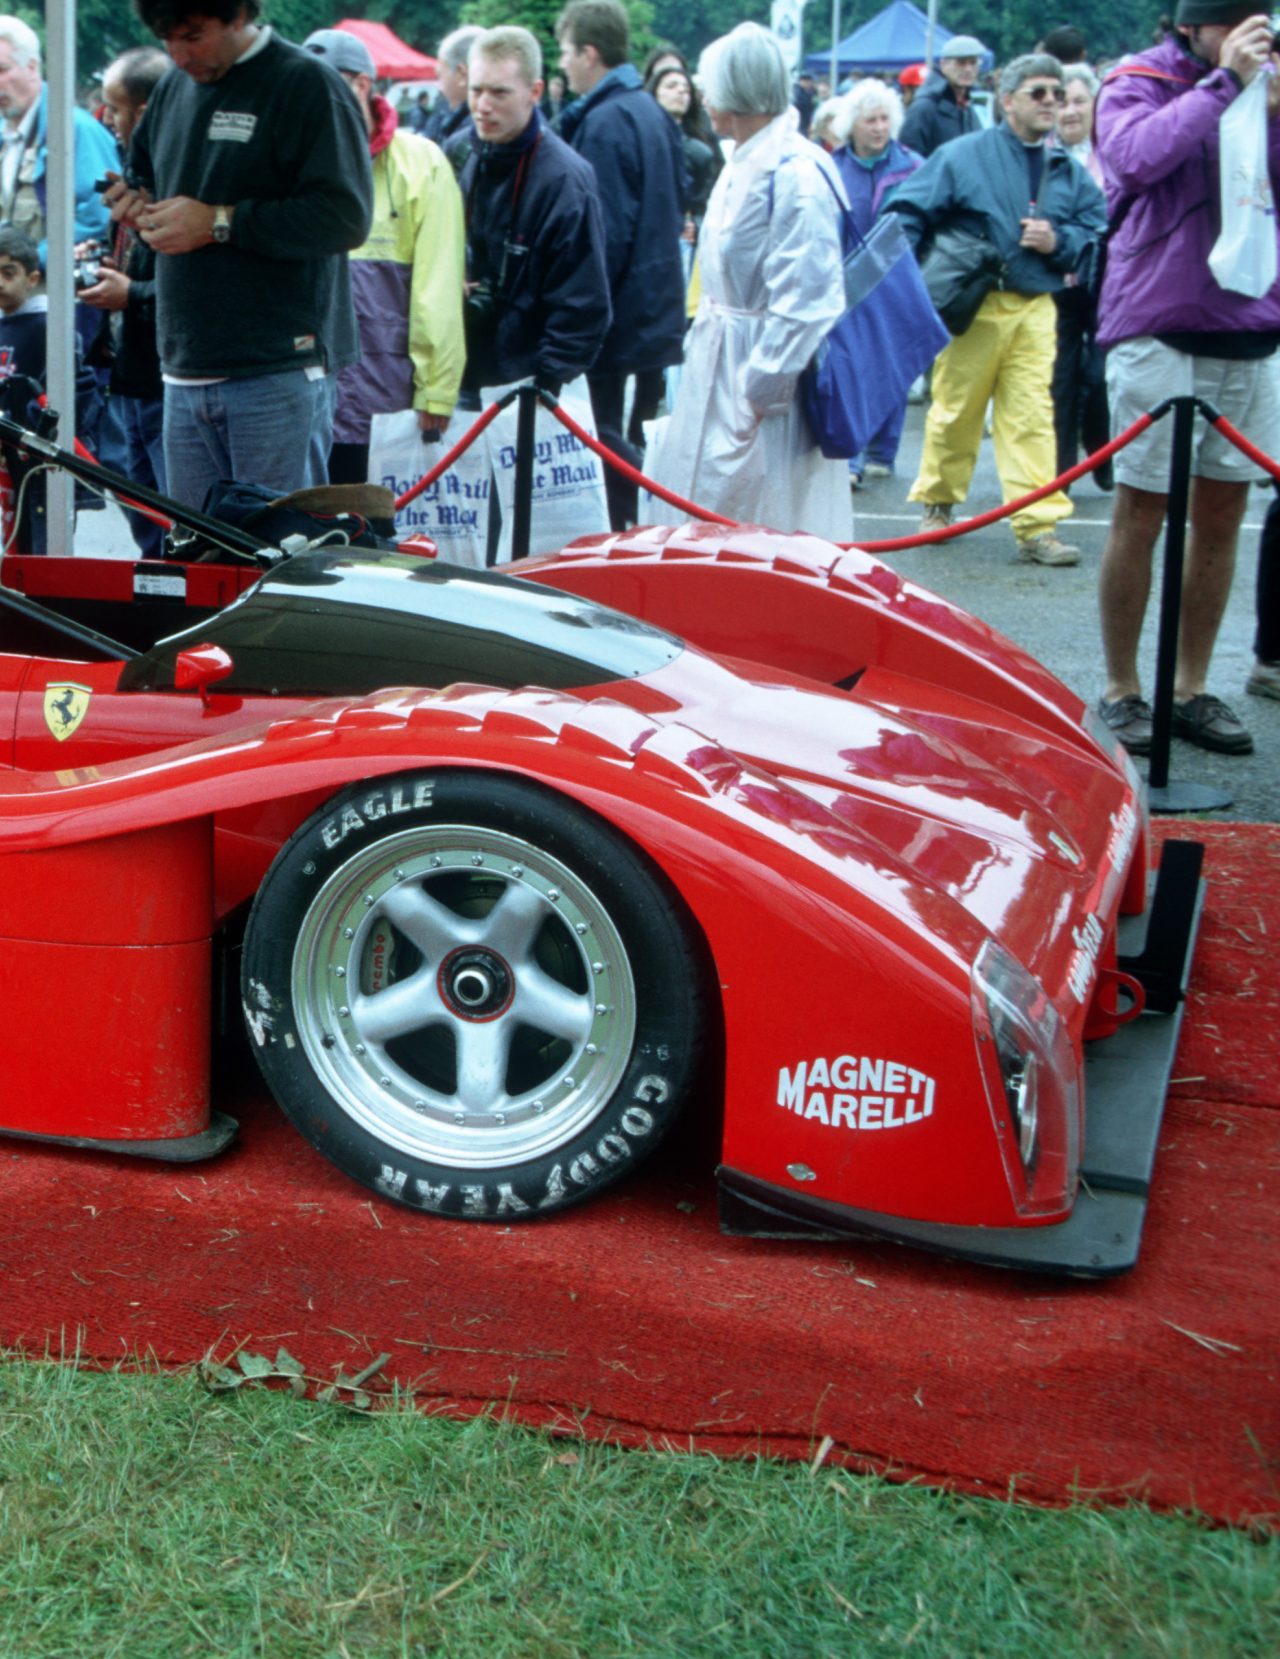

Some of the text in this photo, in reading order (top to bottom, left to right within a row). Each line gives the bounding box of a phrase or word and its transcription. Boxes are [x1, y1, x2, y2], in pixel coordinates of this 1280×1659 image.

[321, 780, 436, 849] EAGLE
[777, 1055, 936, 1110] MAGNETI
[777, 1075, 936, 1131] MARELLI
